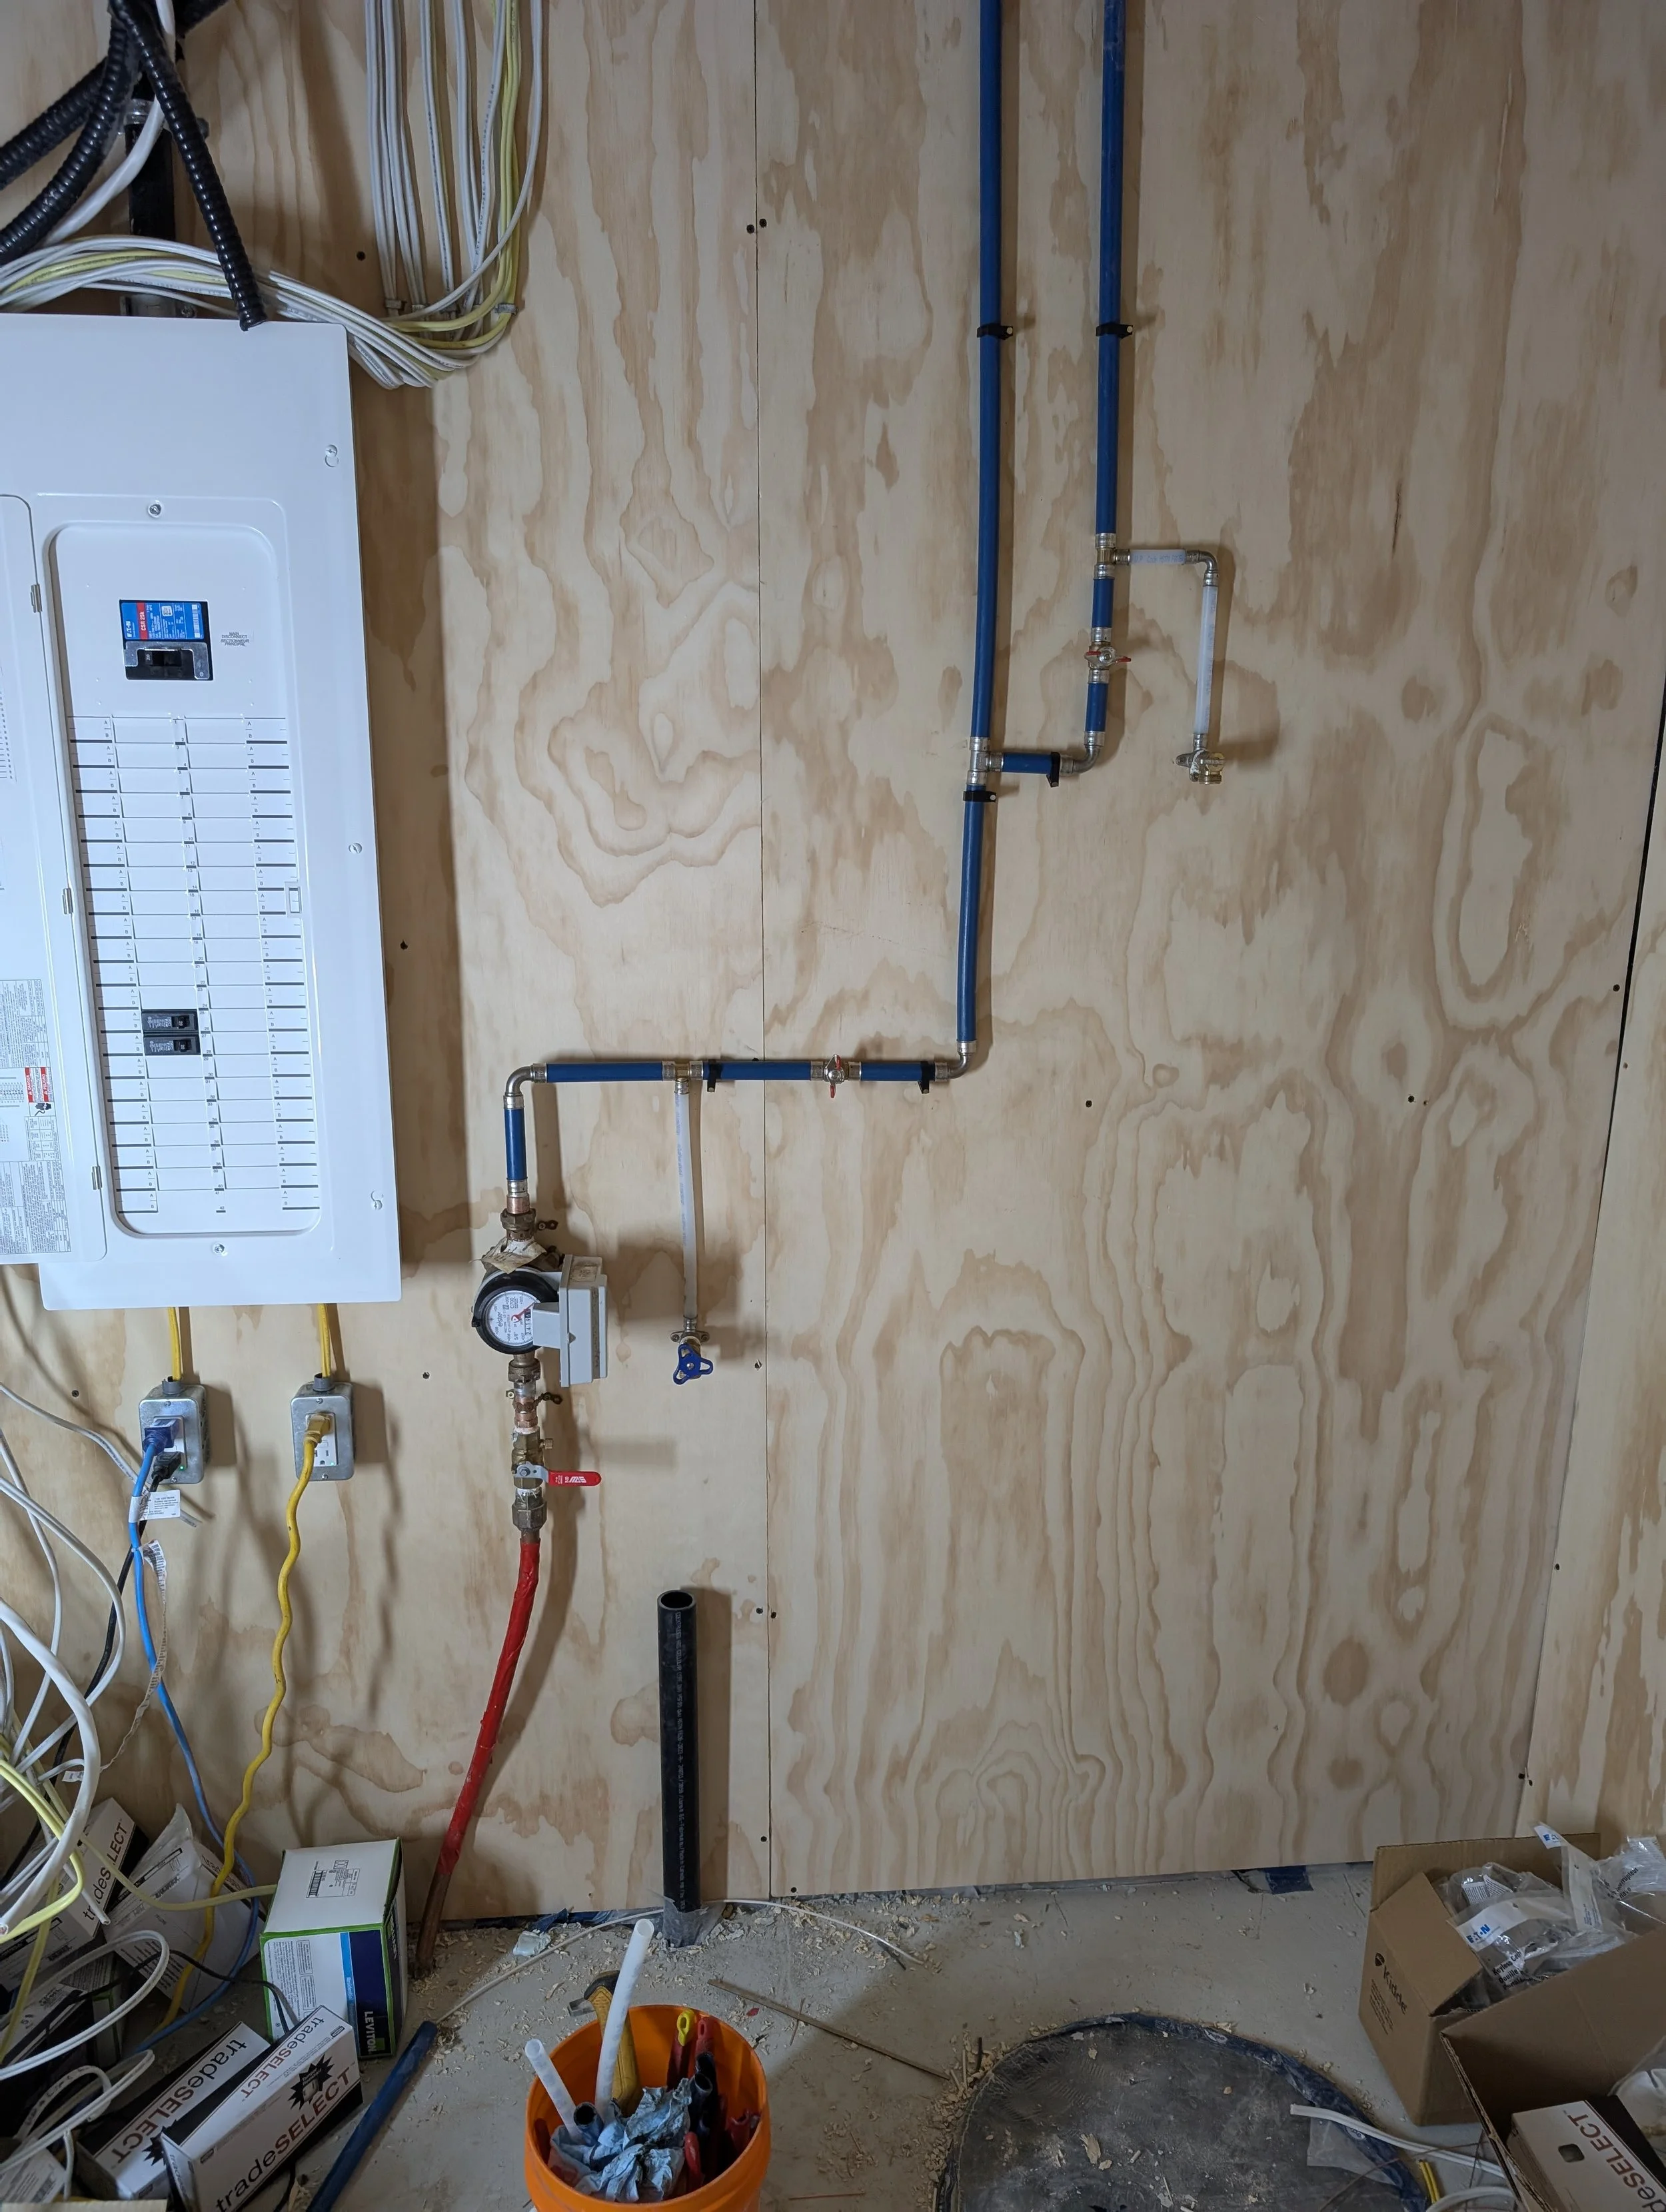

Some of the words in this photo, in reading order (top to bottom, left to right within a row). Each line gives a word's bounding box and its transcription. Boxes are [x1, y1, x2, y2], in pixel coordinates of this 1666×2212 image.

[1383, 1964, 1407, 2015] Kidde
[241, 2016, 325, 2098] tradeSELECT
[364, 2010, 377, 2053] LEVITON
[111, 2039, 248, 2164] tradeSELECT
[215, 2067, 351, 2212] tradeSELECT
